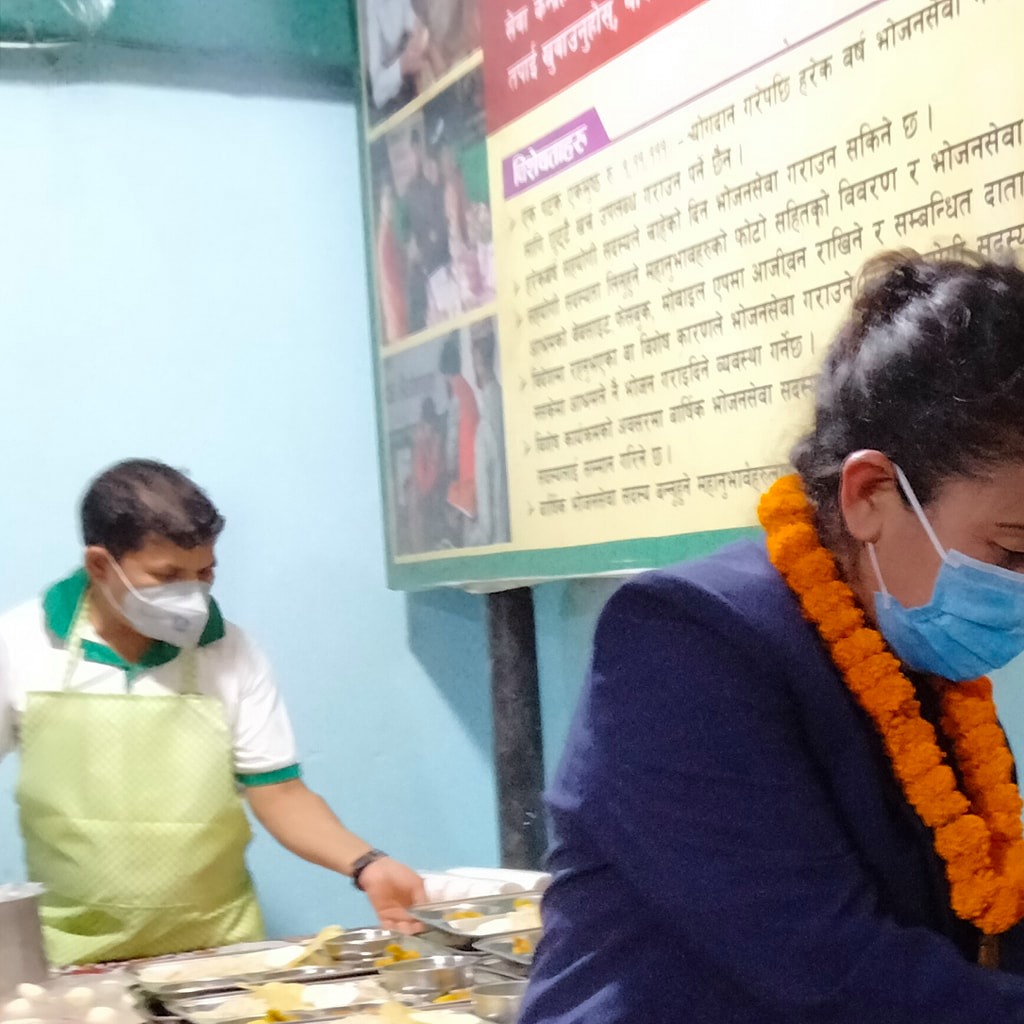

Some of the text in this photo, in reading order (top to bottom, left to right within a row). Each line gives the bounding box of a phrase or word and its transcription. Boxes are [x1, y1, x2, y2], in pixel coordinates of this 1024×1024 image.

[743, 73, 791, 117] गरेपछि
[798, 54, 833, 97] हरेक
[842, 32, 866, 68] वर्ष
[688, 198, 708, 224] दिन
[716, 170, 778, 211] भोजनसेवा
[787, 145, 837, 184] गराउन
[846, 117, 892, 161] सकिने
[902, 110, 918, 139] छ
[734, 213, 767, 247] फोटो
[838, 167, 897, 211] विवरण
[907, 158, 920, 185] र
[931, 119, 1024, 173] भोजनसेवा
[712, 268, 745, 302] एपमा
[815, 222, 863, 264] राखिने
[872, 220, 885, 245] र
[894, 188, 973, 237] सम्बन्धित
[676, 311, 723, 346] कारणले
[731, 294, 795, 328] भोजनसेवा
[716, 345, 762, 373] व्यवस्था
[712, 382, 773, 413] भोजनसेवा
